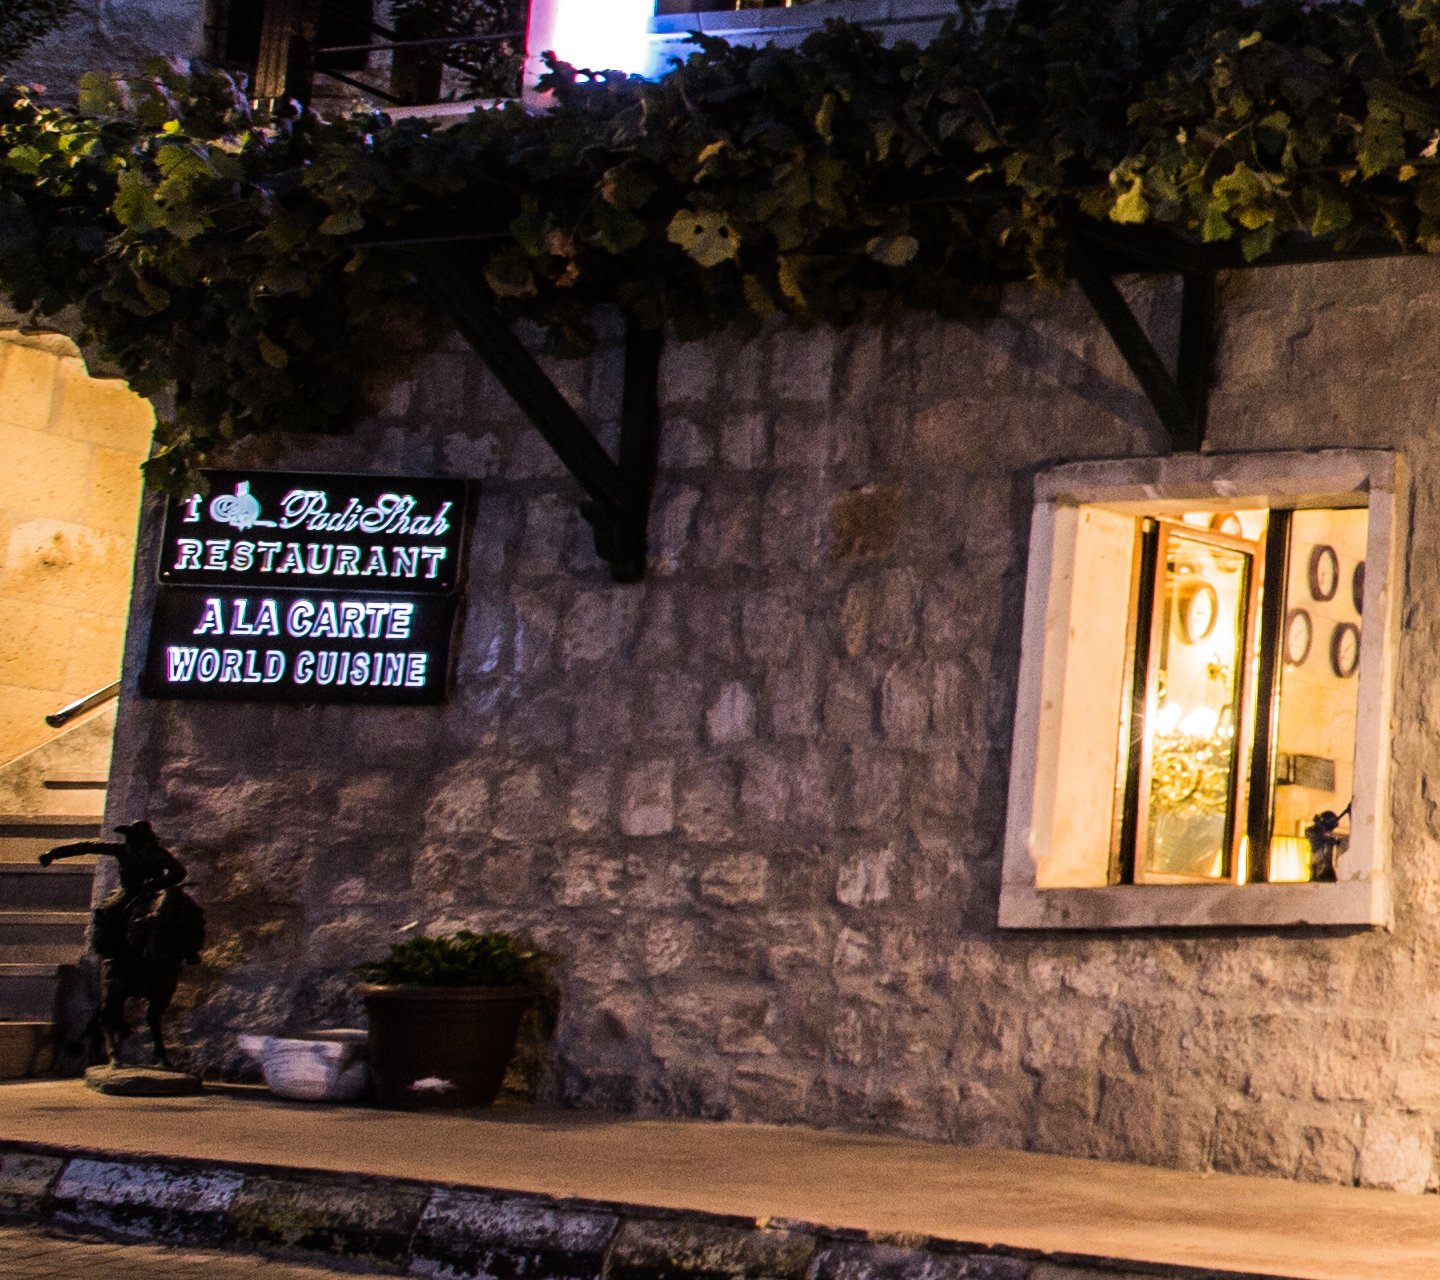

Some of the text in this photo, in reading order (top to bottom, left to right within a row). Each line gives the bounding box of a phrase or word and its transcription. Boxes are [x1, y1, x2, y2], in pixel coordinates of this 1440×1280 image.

[279, 488, 455, 537] PadiShah
[174, 538, 448, 579] RESTAURANT
[192, 598, 416, 639] A LA CARTE
[167, 646, 429, 687] WORLD CUISINE
